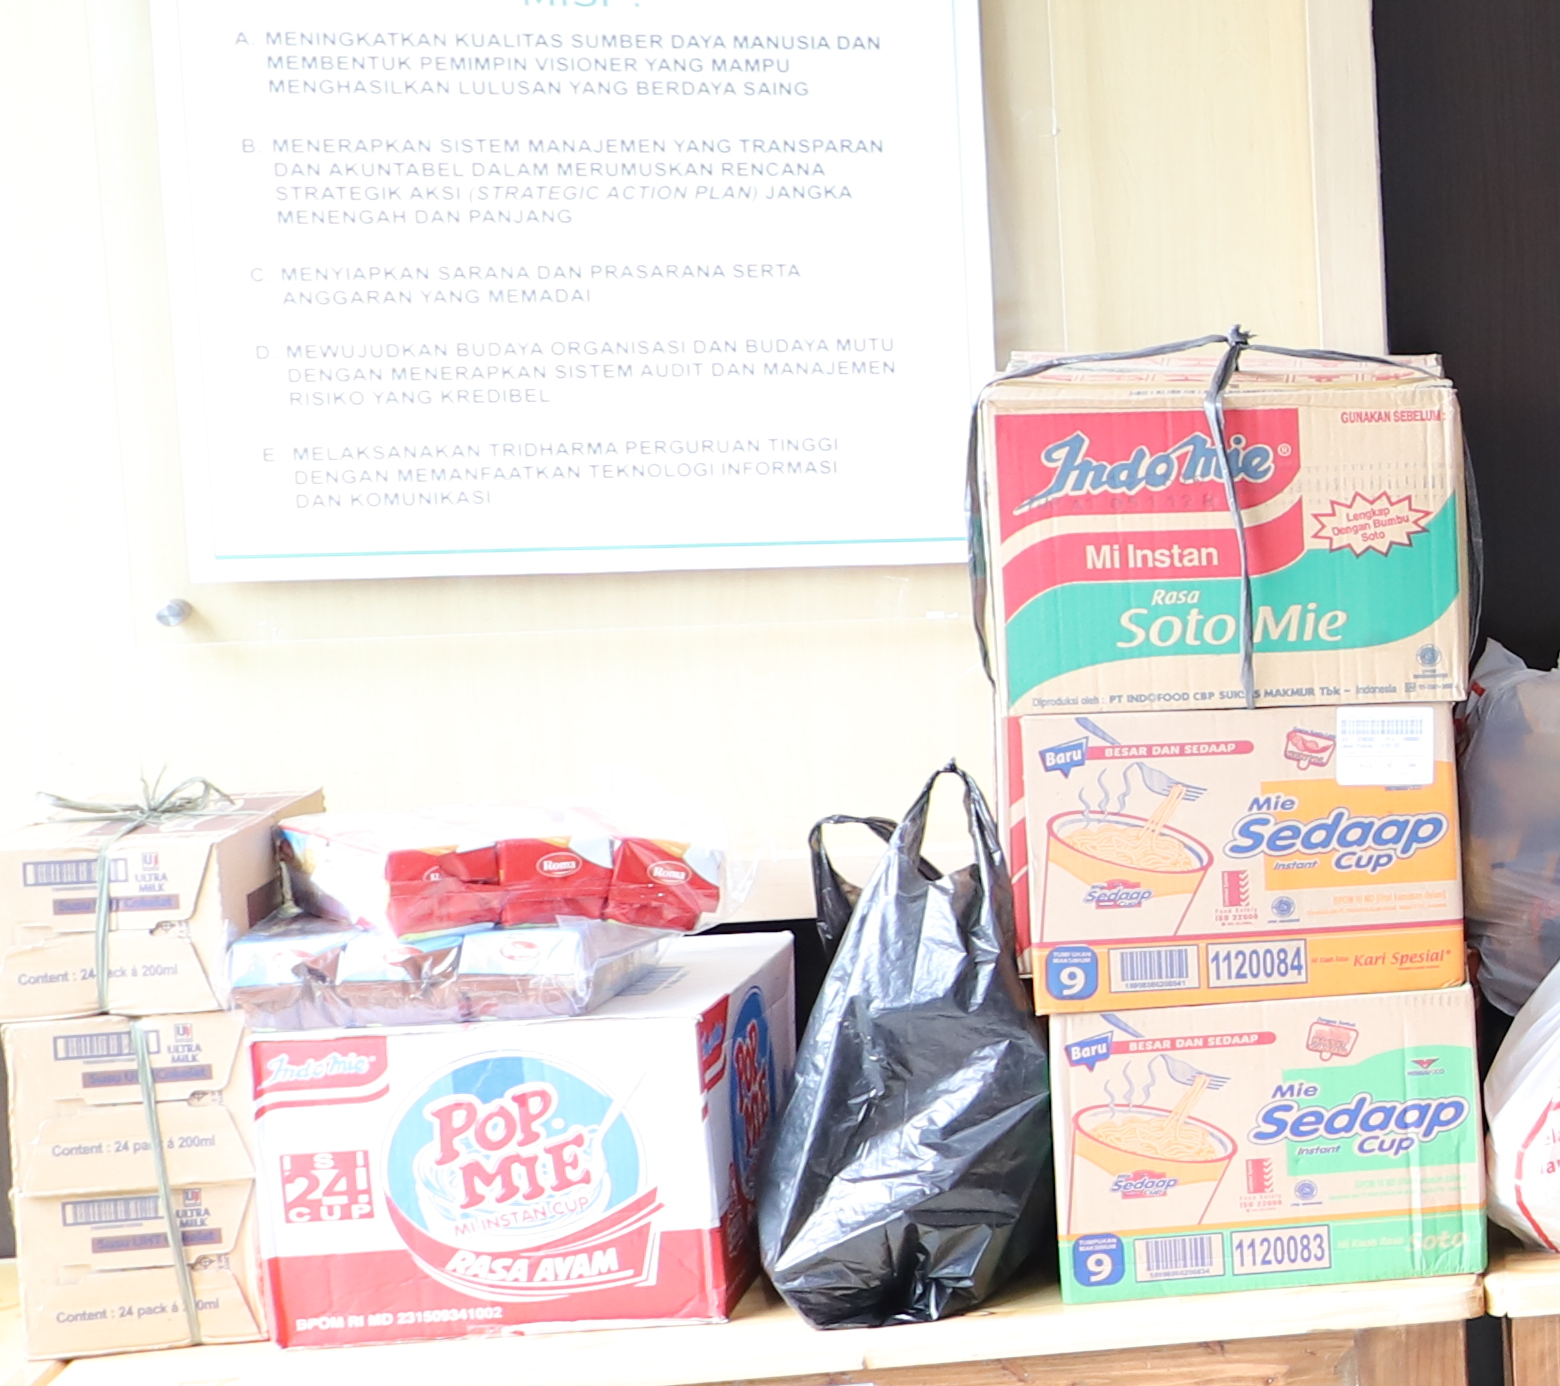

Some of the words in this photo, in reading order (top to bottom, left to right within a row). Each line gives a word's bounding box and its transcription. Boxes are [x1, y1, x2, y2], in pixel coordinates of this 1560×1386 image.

[265, 31, 447, 47] MENINGKATKAN
[455, 33, 563, 48] KUALITAS
[571, 34, 663, 49] SUMBER
[671, 34, 727, 50] DAYA
[733, 35, 832, 50] MANUSIA
[836, 35, 881, 51] DAN
[267, 55, 412, 71] MEMBENTUK
[420, 56, 527, 71] PEMIMPIN
[535, 57, 638, 72] VISIONER
[645, 58, 704, 73] YANG
[711, 58, 790, 73] MAMPU
[269, 79, 450, 95] MENGHASILKAN
[459, 80, 562, 95] LULUSAN
[569, 81, 629, 96] YANG
[636, 81, 737, 96] BERDAYA
[743, 82, 809, 97] SAING
[1340, 410, 1391, 424] GUNAKAN
[1346, 506, 1390, 523] Lengkap
[1331, 522, 1371, 537] Dengan
[1373, 514, 1410, 529] Bumbu
[1360, 530, 1386, 542] Soto
[1085, 544, 1120, 569] Mi
[1128, 543, 1219, 569] Instan
[1151, 588, 1201, 607] Rasa
[1116, 606, 1237, 649] Soto
[1253, 602, 1348, 644] Mie
[1109, 693, 1124, 704] PT
[1264, 687, 1316, 699] MAKMUR
[1320, 686, 1341, 697] Tbk
[1045, 747, 1082, 767] Baru
[1104, 745, 1148, 759] BESAR
[1152, 744, 1180, 756] DAN
[1184, 742, 1236, 755] SEDAAP
[1248, 795, 1296, 813] Mie
[1228, 811, 1445, 856] Sedaap
[542, 858, 579, 873] Roma
[1333, 850, 1394, 873] Cup
[653, 866, 686, 880] Roma
[1210, 946, 1304, 981] 1120084
[1353, 950, 1386, 968] Kari
[17, 971, 71, 986] Content
[1058, 965, 1087, 996] 9
[1070, 1041, 1108, 1061] Baru
[1128, 1039, 1171, 1053] BESAR
[1175, 1037, 1204, 1049] DAN
[1207, 1034, 1259, 1047] SEDAAP
[1271, 1082, 1319, 1100] Mie
[1252, 1096, 1466, 1142] Sedaap
[52, 1142, 103, 1157] Content
[114, 1140, 130, 1153] 24
[1357, 1135, 1415, 1157] Cup
[458, 1131, 592, 1210] MIE
[288, 1203, 372, 1223] CUP
[454, 1218, 476, 1238] MI
[482, 1206, 548, 1231] INSTAN
[556, 1195, 589, 1215] CUP
[446, 1249, 531, 1282] RASA
[533, 1246, 620, 1282] AYAM
[1084, 1252, 1113, 1283] 9
[1235, 1233, 1326, 1267] 1120083
[56, 1309, 108, 1324] Content
[118, 1306, 134, 1318] 24
[137, 1303, 167, 1319] pack
[296, 1316, 345, 1332] BPOM
[348, 1315, 364, 1328] RI
[368, 1313, 394, 1327] MD
